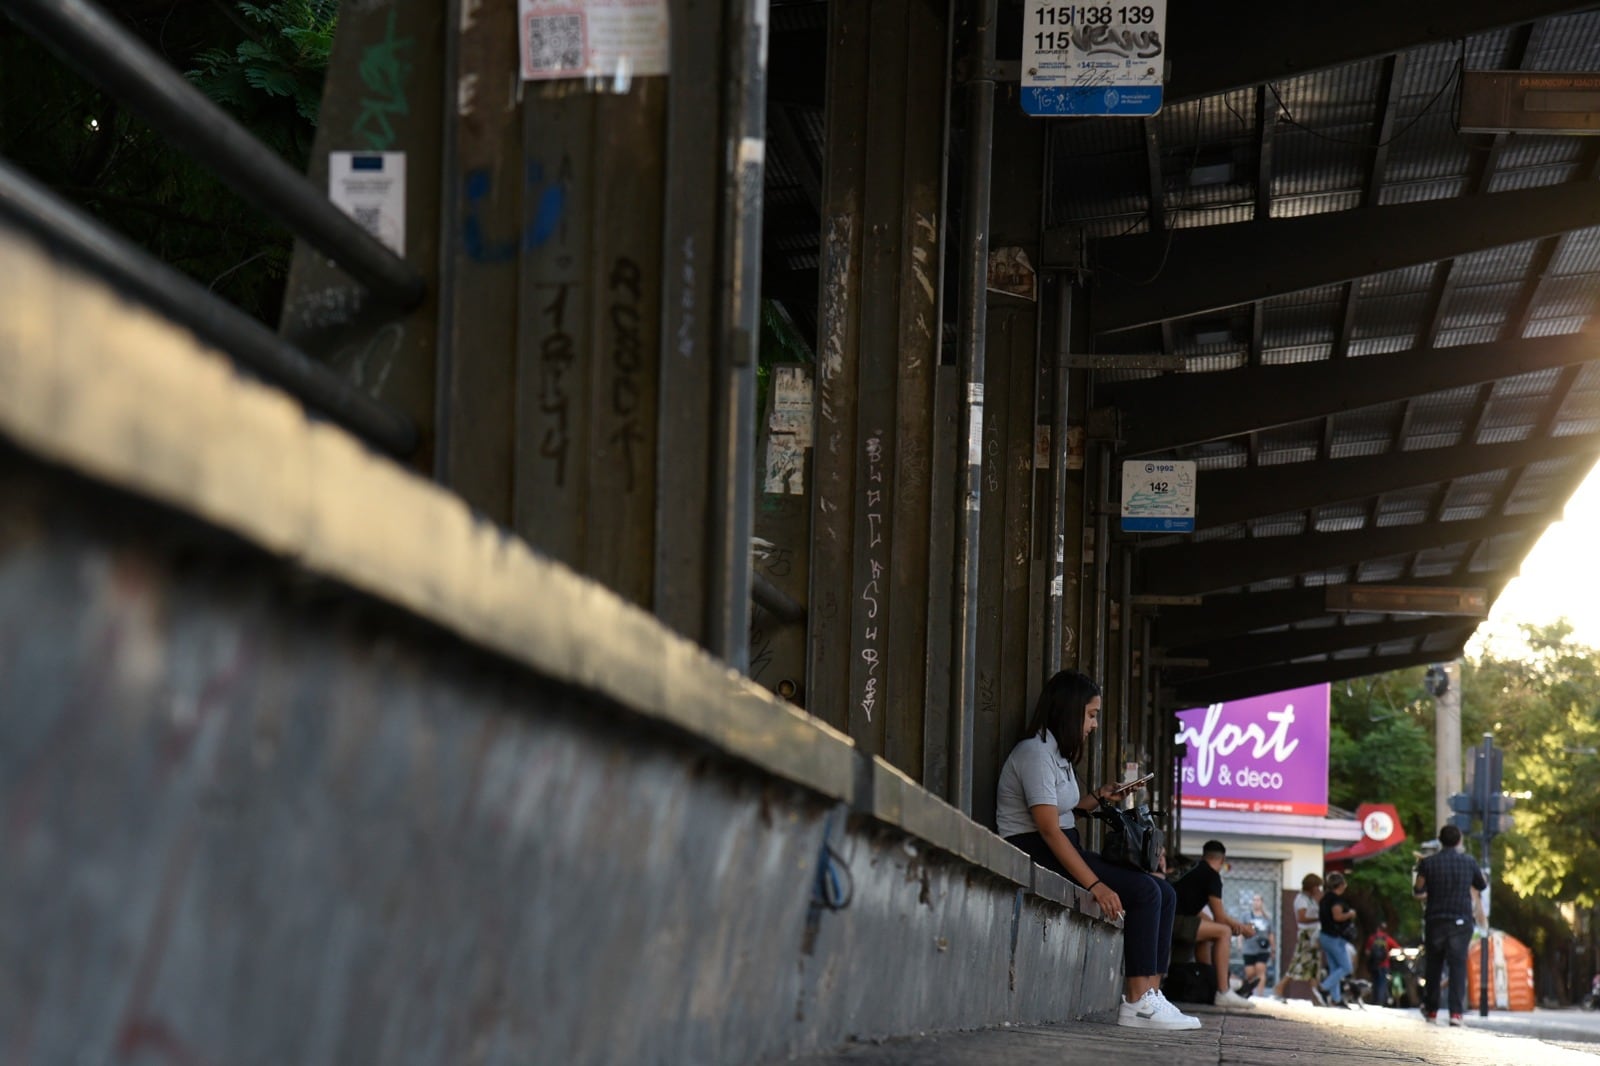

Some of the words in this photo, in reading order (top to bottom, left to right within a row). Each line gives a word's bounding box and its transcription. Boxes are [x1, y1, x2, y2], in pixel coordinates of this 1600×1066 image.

[1036, 7, 1070, 25] 115
[1077, 6, 1112, 25] 138
[1118, 6, 1154, 24] 139
[1035, 32, 1069, 49] 115
[1150, 482, 1168, 492] 142
[1175, 703, 1299, 787] nfort
[1218, 764, 1232, 785] &
[1236, 767, 1283, 789] deco
